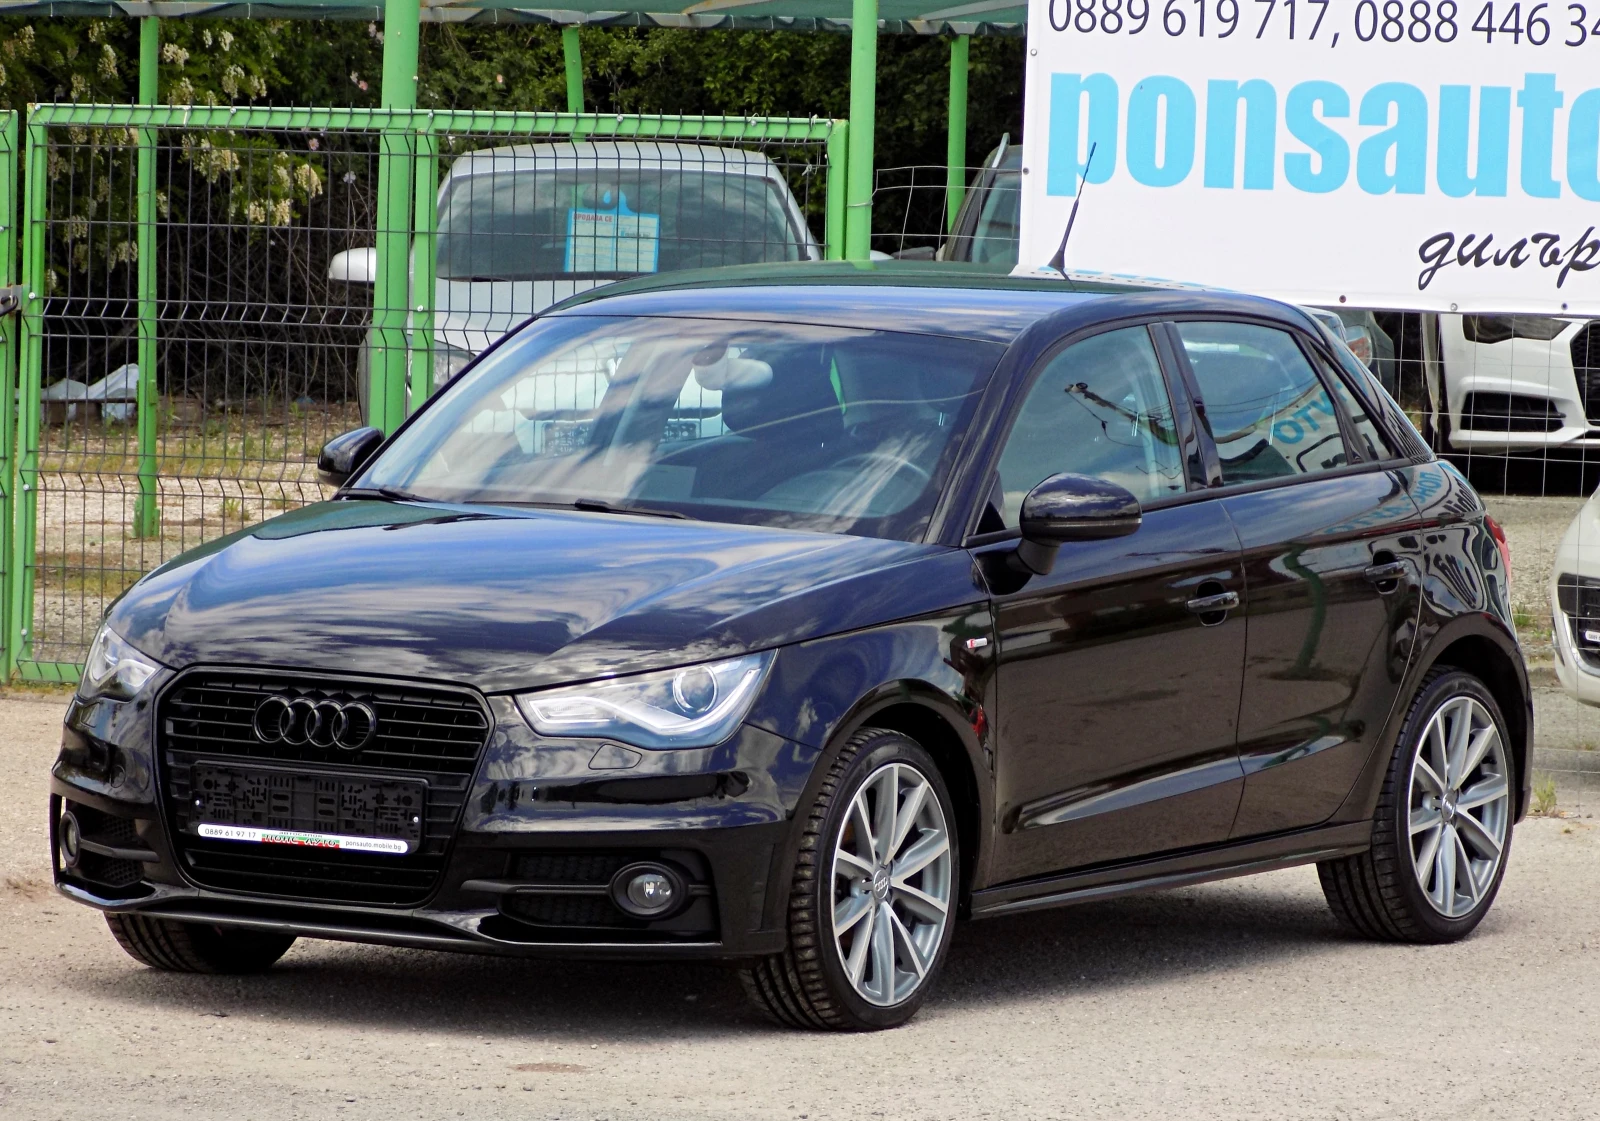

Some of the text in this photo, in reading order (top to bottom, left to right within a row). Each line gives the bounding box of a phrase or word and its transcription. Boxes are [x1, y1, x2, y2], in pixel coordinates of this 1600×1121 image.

[1048, 0, 1150, 35] 0889
[1163, 0, 1240, 39] 619
[1255, 0, 1340, 48] 717,
[1354, 0, 1459, 43] 0888
[1471, 0, 1551, 46] 446
[204, 828, 257, 839] 0889 61 97 17
[345, 840, 402, 851] ponsauto.mobile.bg
